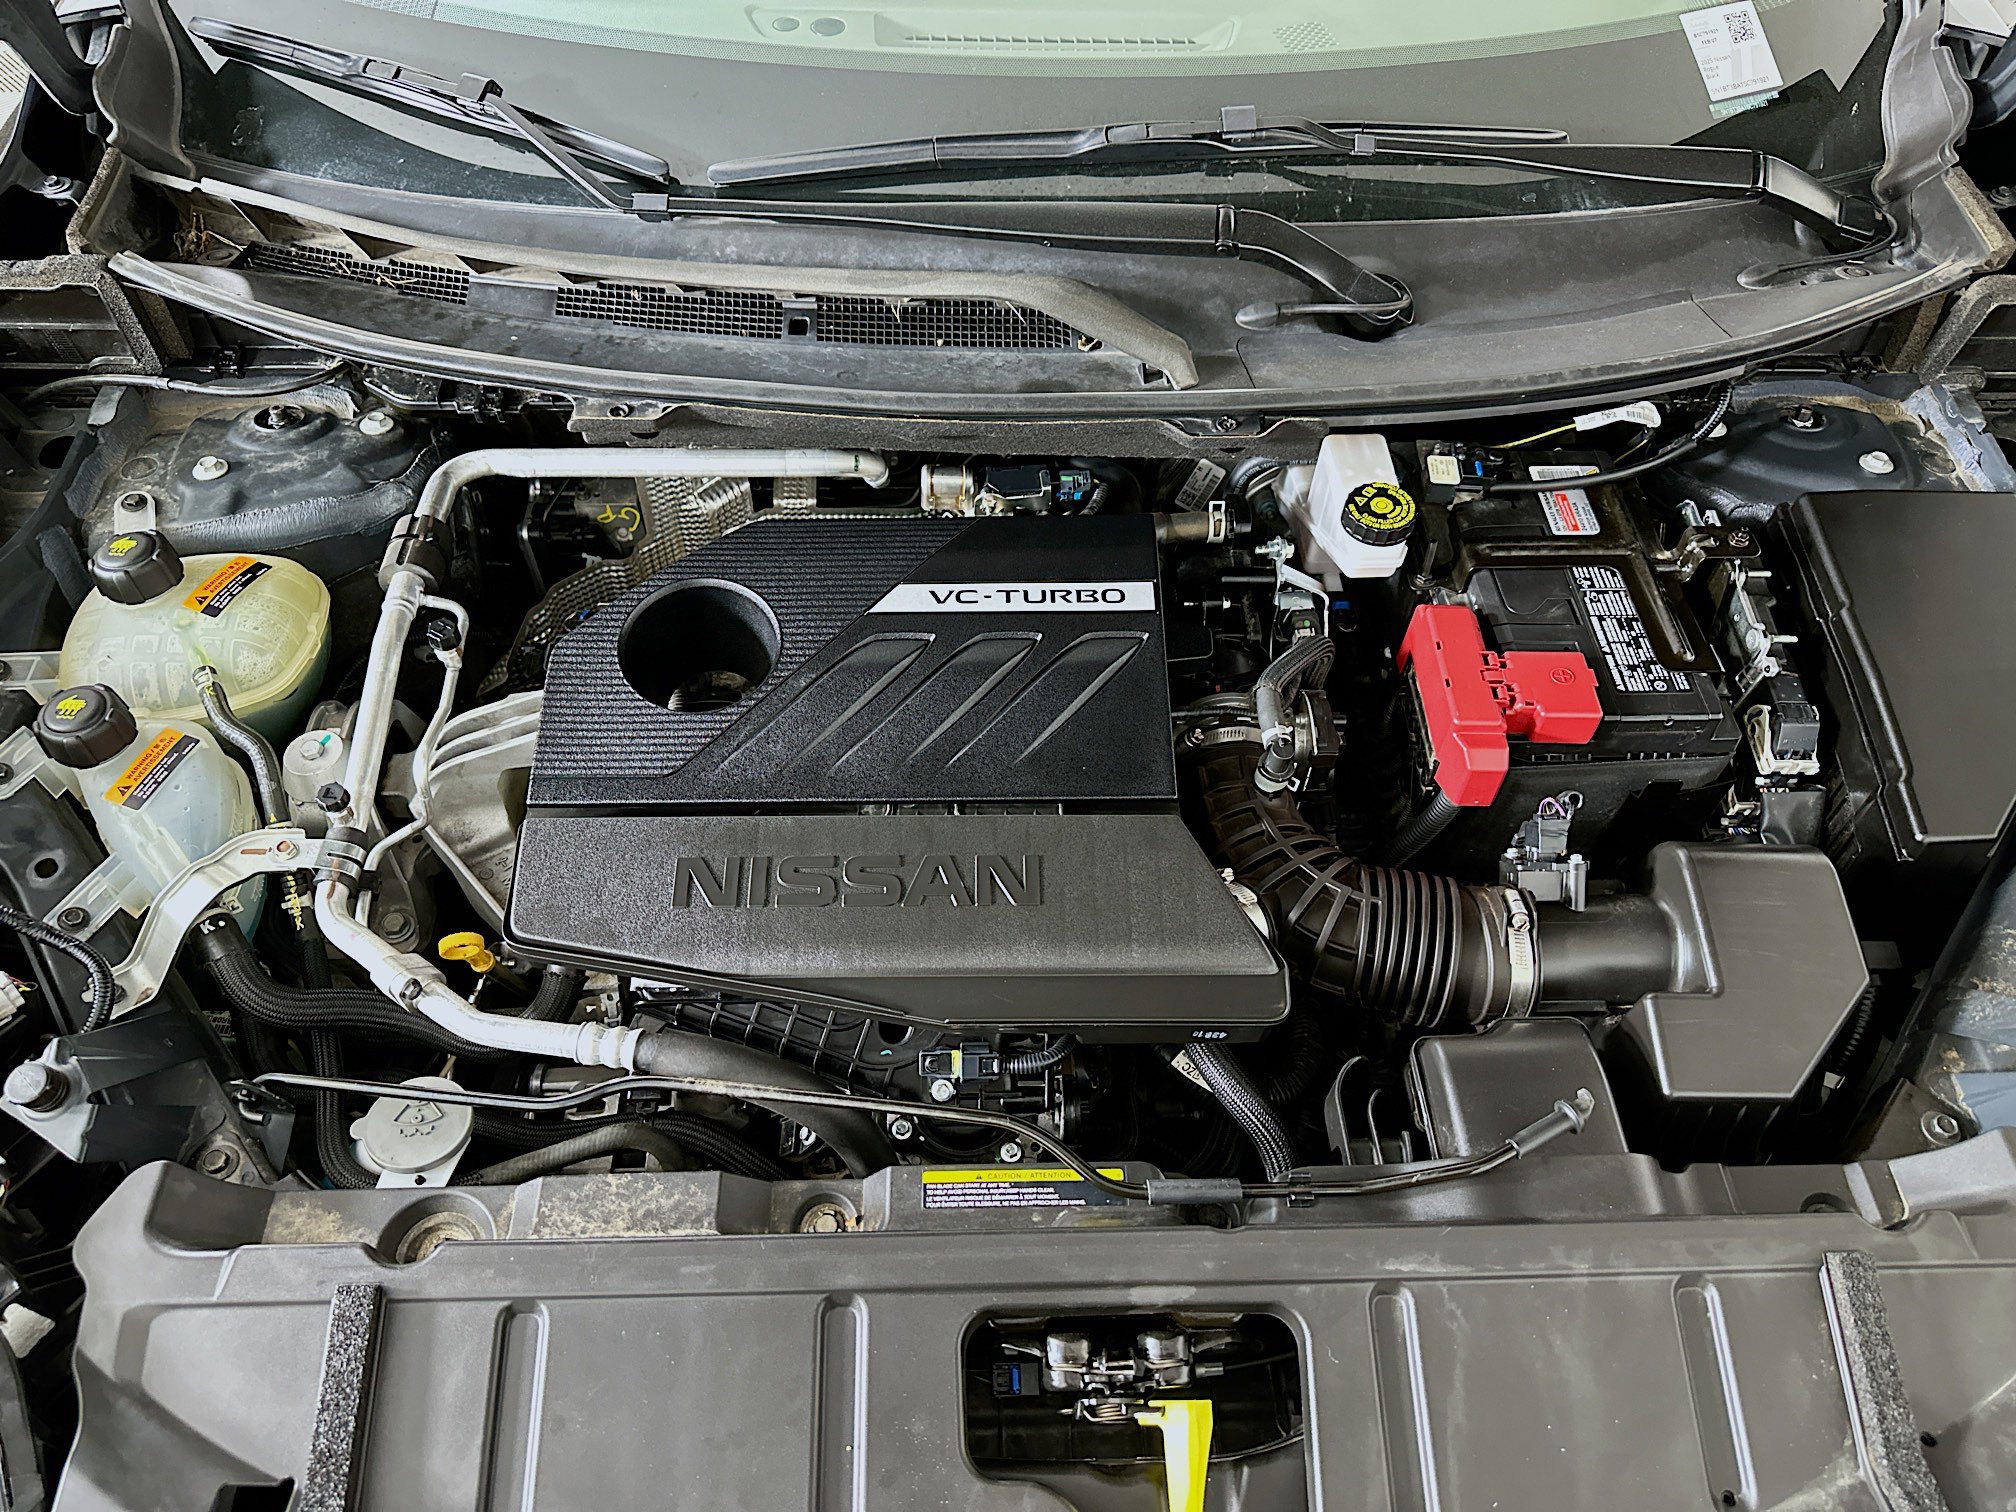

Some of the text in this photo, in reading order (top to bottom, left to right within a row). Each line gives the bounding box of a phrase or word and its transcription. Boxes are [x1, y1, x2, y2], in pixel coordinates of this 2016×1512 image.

[1541, 492, 1552, 510] NISSA
[929, 588, 1127, 605] VC-TURBO
[126, 753, 153, 780] WARNING
[133, 736, 176, 783] AVERTISSEMENT
[671, 854, 1045, 908] NISSAN
